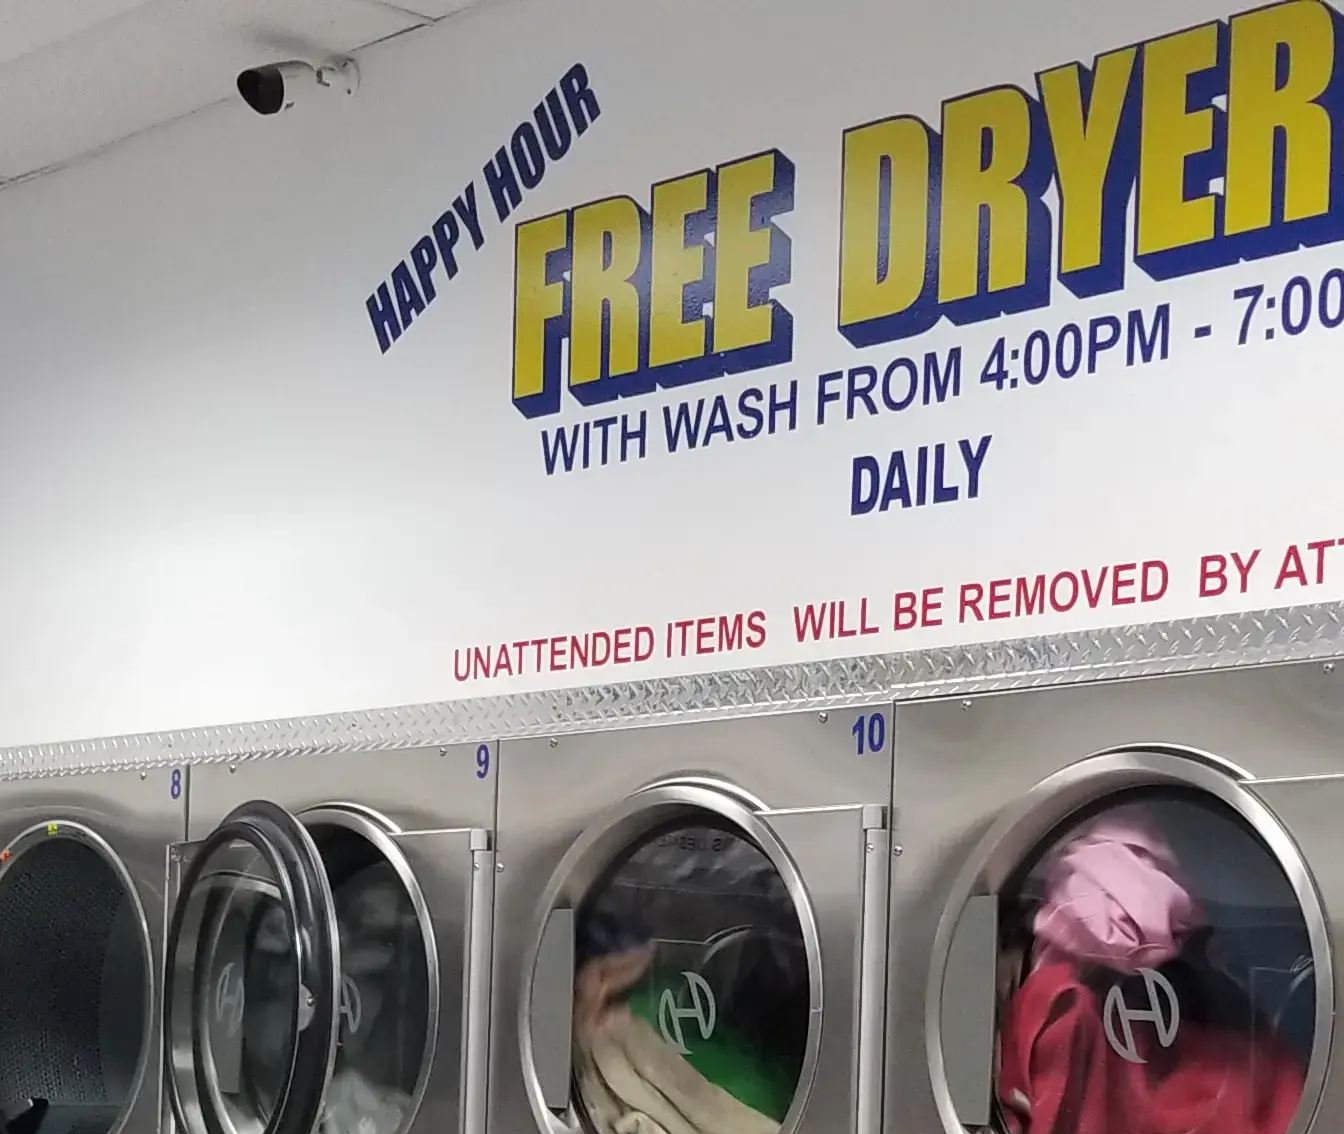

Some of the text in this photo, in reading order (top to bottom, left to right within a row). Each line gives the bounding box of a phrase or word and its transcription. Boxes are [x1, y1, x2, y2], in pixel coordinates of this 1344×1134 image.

[366, 63, 601, 354] HAPPY HOUR
[512, 148, 795, 419] FREE
[542, 410, 647, 475] WITH
[662, 380, 798, 453] WASH
[817, 346, 962, 424] FROM
[980, 303, 1171, 391] 4:00PM
[851, 435, 992, 515] DAILY
[453, 626, 654, 682] UNATTENDED
[665, 610, 767, 659] ITEMS
[792, 597, 880, 643] WILL
[893, 586, 944, 631] BE
[959, 559, 1169, 622] REMOVED
[1198, 549, 1261, 598] BY
[170, 768, 181, 799] 8
[476, 744, 490, 779] 9
[852, 713, 885, 755] 10
